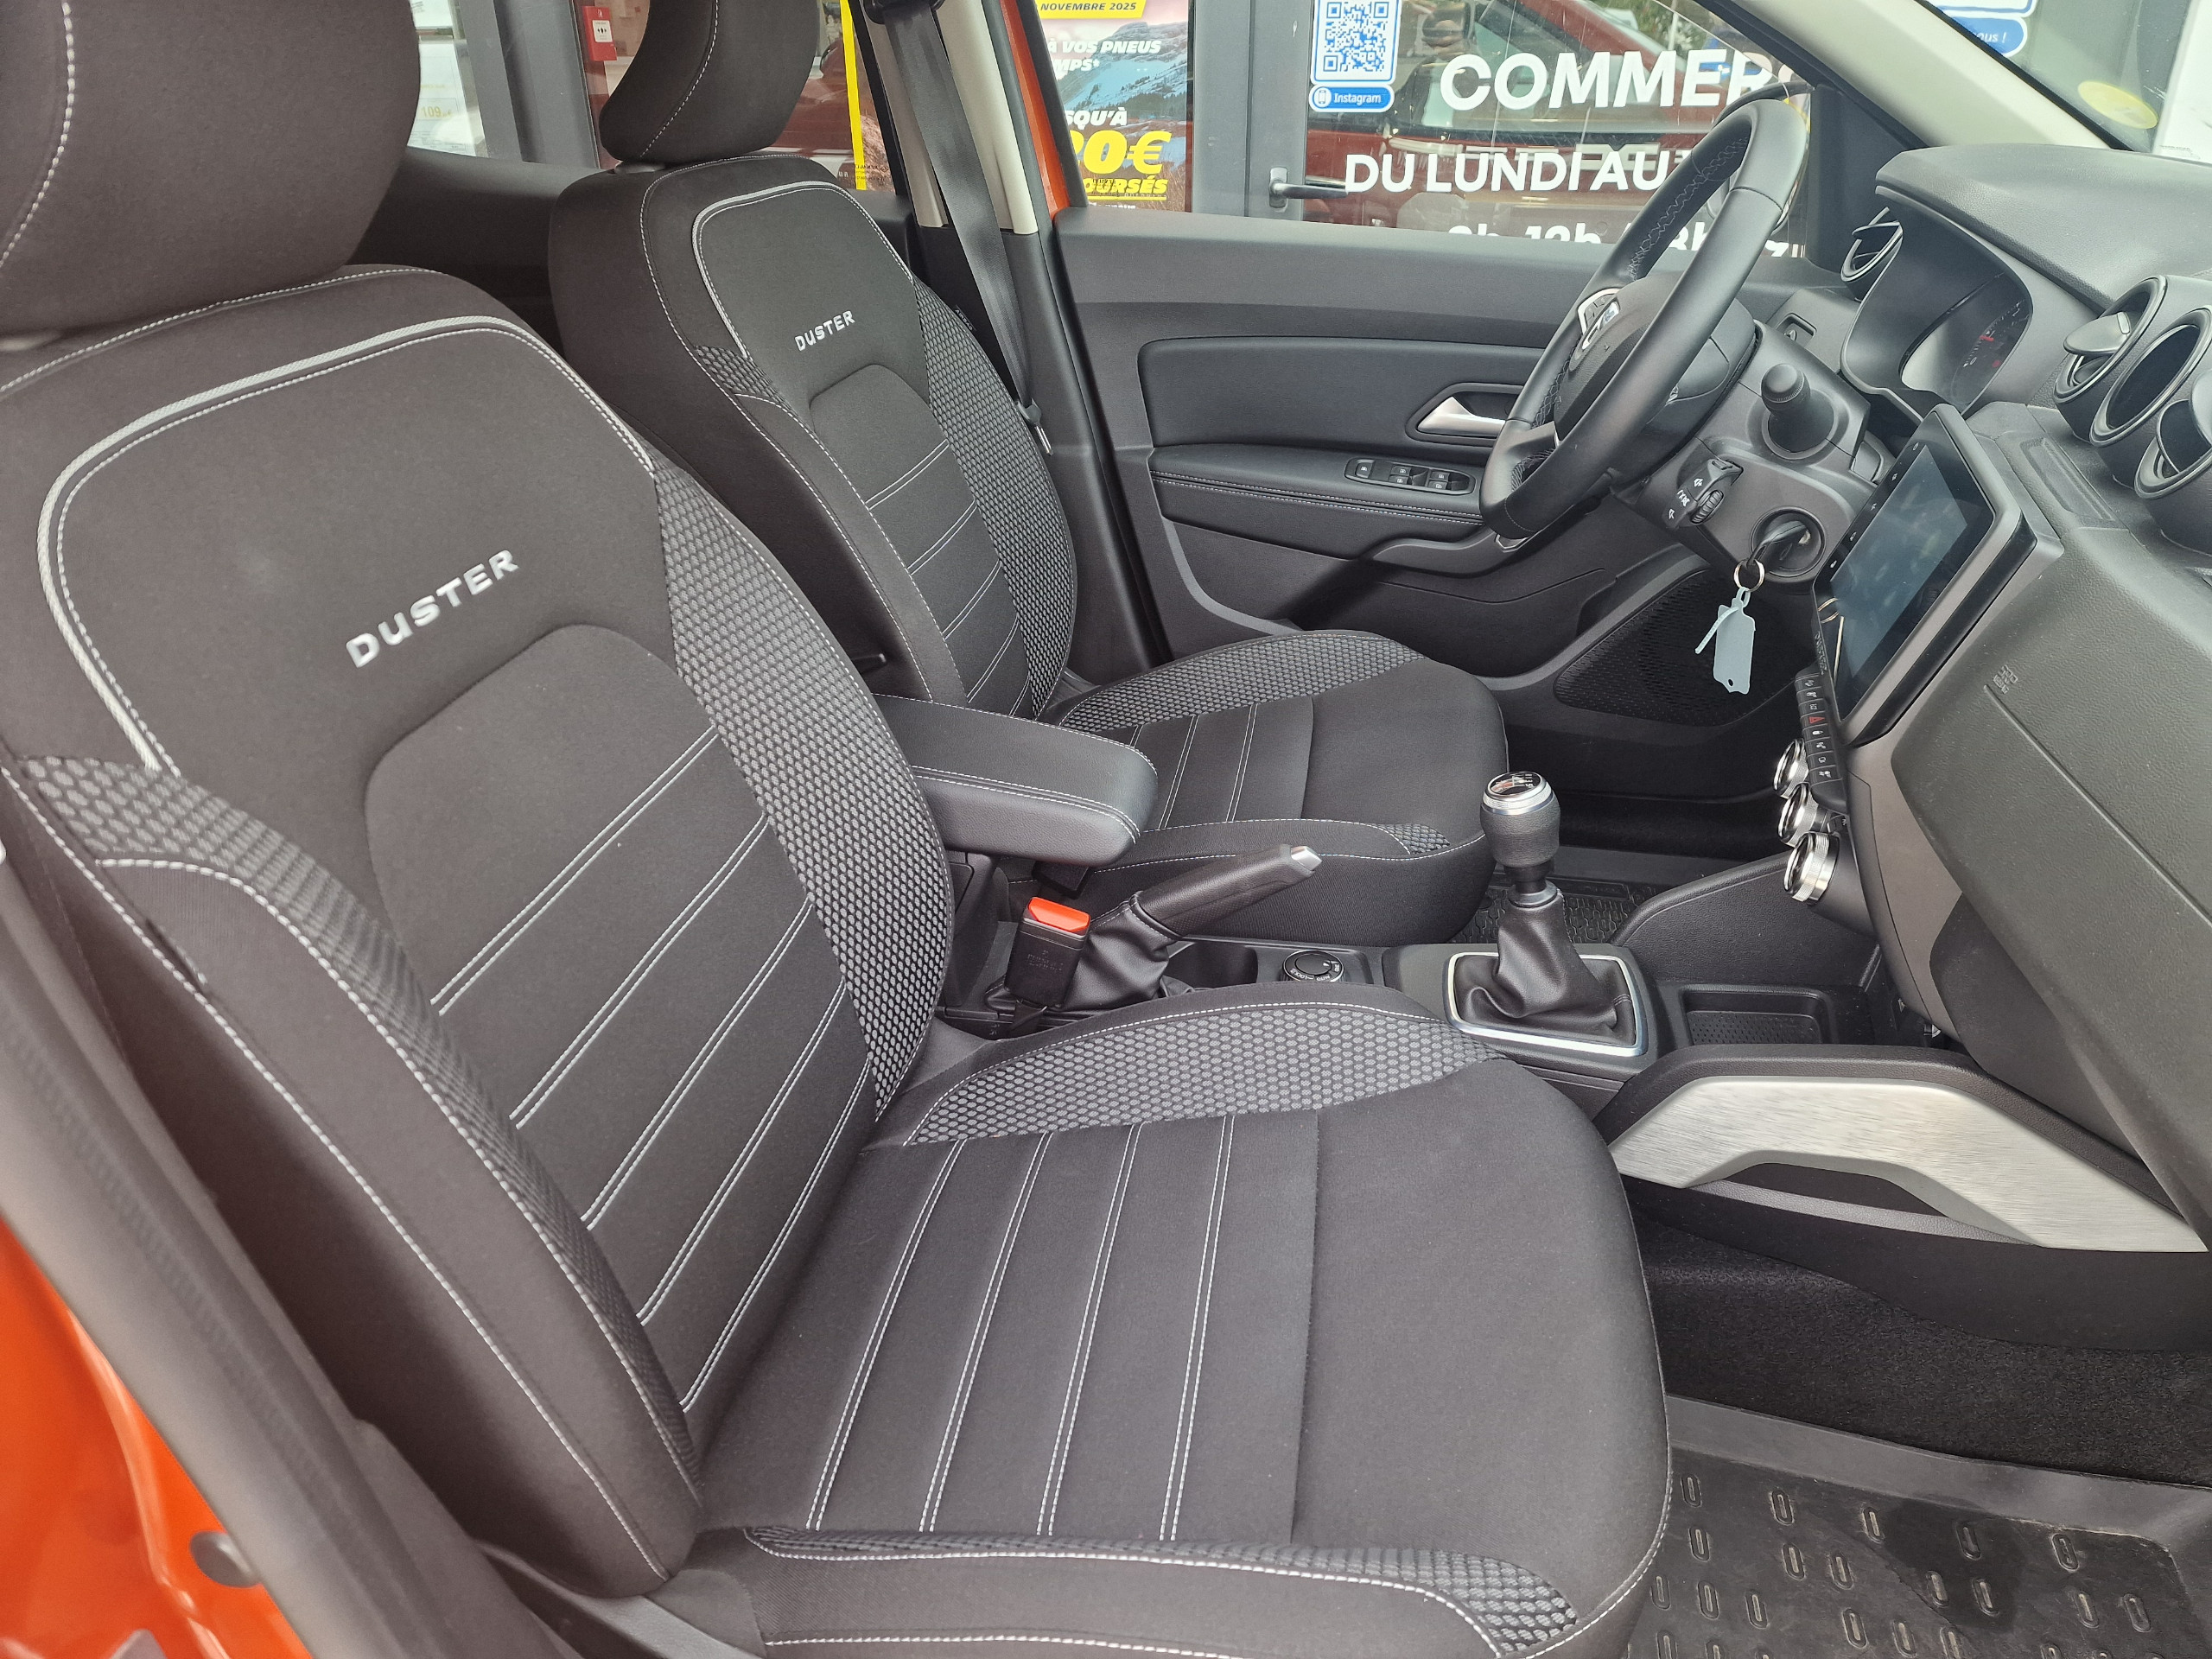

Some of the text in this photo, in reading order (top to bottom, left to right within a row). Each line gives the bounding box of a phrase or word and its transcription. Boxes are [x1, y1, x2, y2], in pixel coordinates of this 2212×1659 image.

[1040, 3, 1106, 11] NOVEMBRE
[1975, 32, 1999, 43] ous
[1062, 41, 1098, 54] VOS
[1100, 41, 1162, 54] PNEUS
[1333, 92, 1382, 106] Instagram
[1345, 150, 1670, 194] DU LUNDI AU
[794, 310, 855, 352] DUSTER
[346, 550, 519, 668] DUSTER
